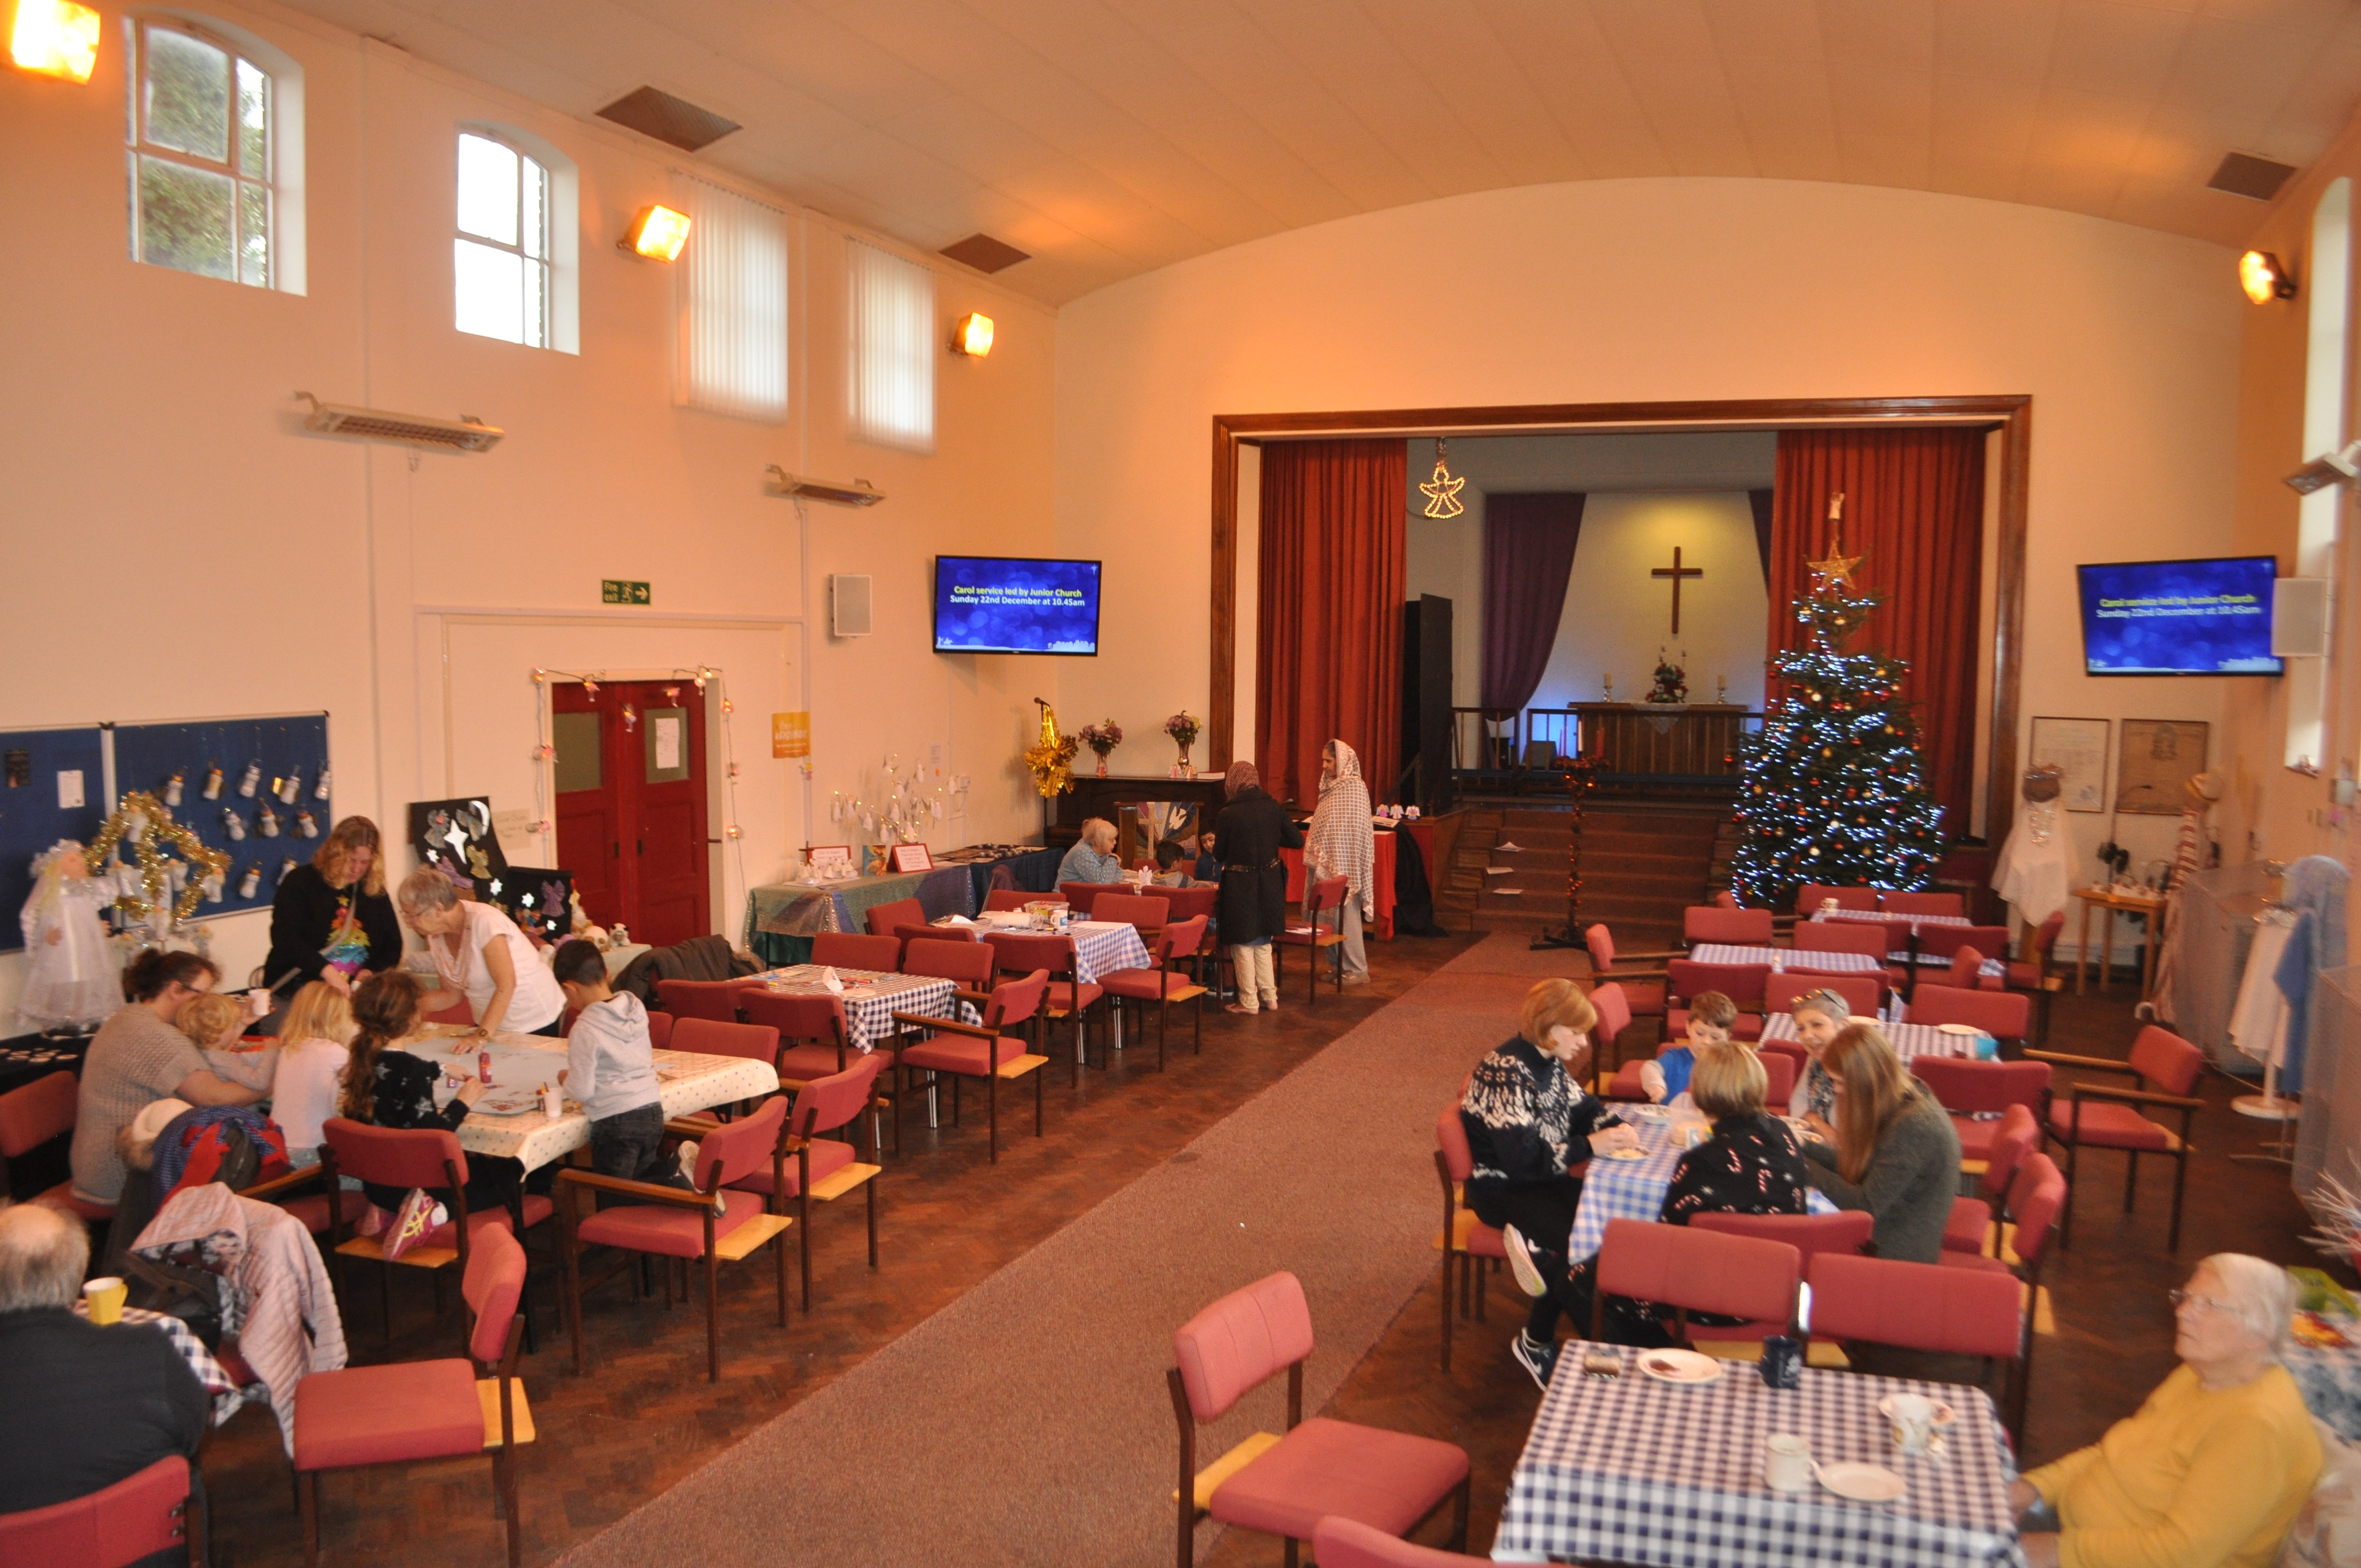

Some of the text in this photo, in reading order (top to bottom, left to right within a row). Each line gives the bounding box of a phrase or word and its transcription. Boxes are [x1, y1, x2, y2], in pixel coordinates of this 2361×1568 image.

[954, 586, 1082, 598] Carol service led by Junior Church
[950, 595, 979, 605] Sunday
[980, 596, 1000, 604] 22nd
[1002, 596, 1041, 605] December
[1052, 598, 1085, 607] 10.45am
